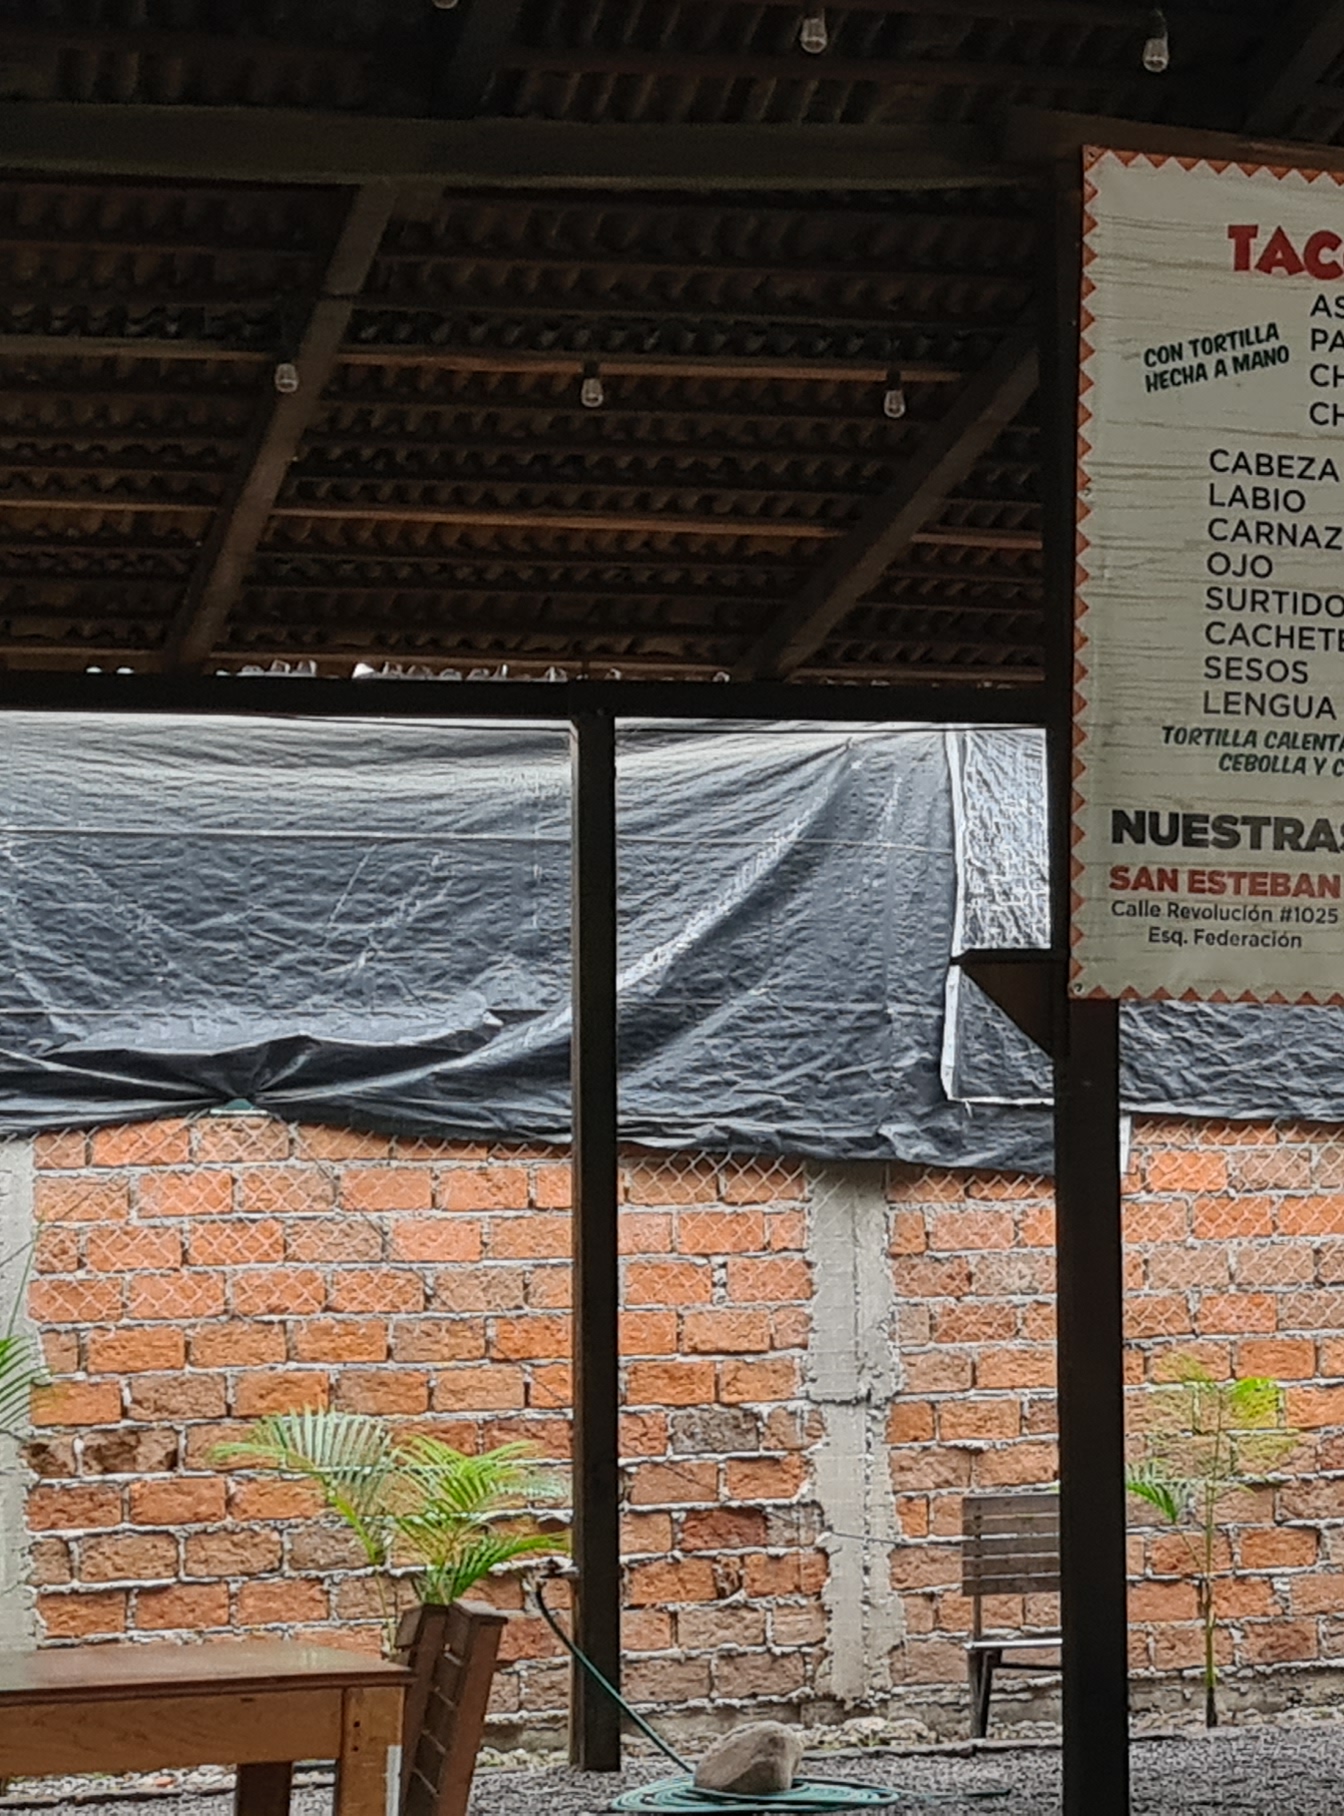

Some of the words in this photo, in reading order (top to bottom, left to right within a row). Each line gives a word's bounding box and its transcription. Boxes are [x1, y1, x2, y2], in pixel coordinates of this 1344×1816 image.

[1143, 341, 1184, 368] CON
[1189, 322, 1279, 359] TORTILLA
[1144, 362, 1209, 393] HECHA
[1214, 358, 1228, 379] A
[1231, 344, 1290, 375] MANO
[1209, 448, 1340, 483] CABEZA
[1209, 482, 1306, 514] LABIO
[1206, 551, 1273, 579] OJO
[1203, 655, 1309, 685] SESOS
[1203, 690, 1337, 721] LENGUA
[1161, 725, 1258, 749] TORTILLA
[1218, 752, 1307, 775] CEBOLLA
[1313, 756, 1328, 776] Y
[1108, 864, 1180, 893] SAN
[1187, 868, 1341, 899] ESTEBAN
[1110, 898, 1162, 918] Calle
[1166, 900, 1273, 923] Revolución
[1279, 905, 1339, 925] #1025
[1148, 925, 1188, 948] Esq.
[1193, 928, 1303, 949] Federación
